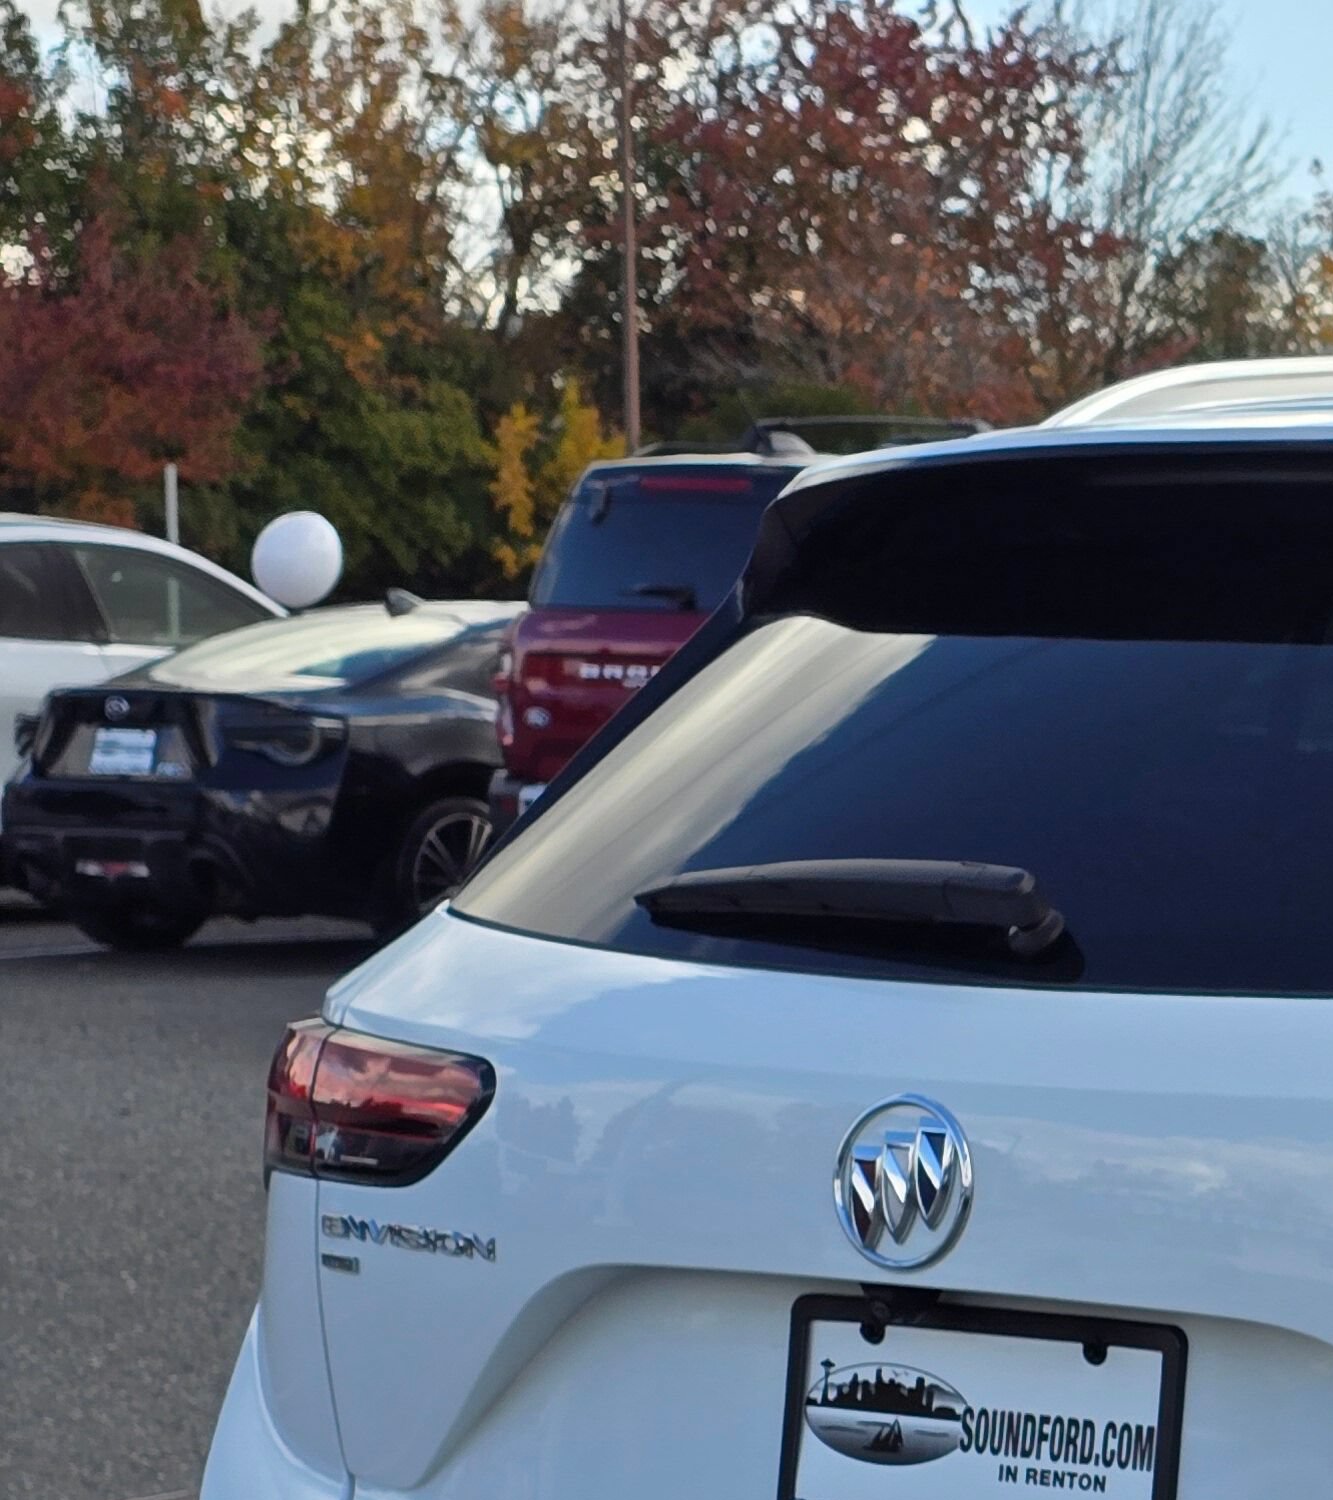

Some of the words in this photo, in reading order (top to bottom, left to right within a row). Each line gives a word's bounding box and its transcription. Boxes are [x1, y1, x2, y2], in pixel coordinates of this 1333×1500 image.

[321, 1214, 496, 1262] ENVISION
[959, 1406, 1155, 1472] SOUNDFORD.COM
[998, 1464, 1019, 1483] IN
[1025, 1467, 1106, 1493] RENTON
